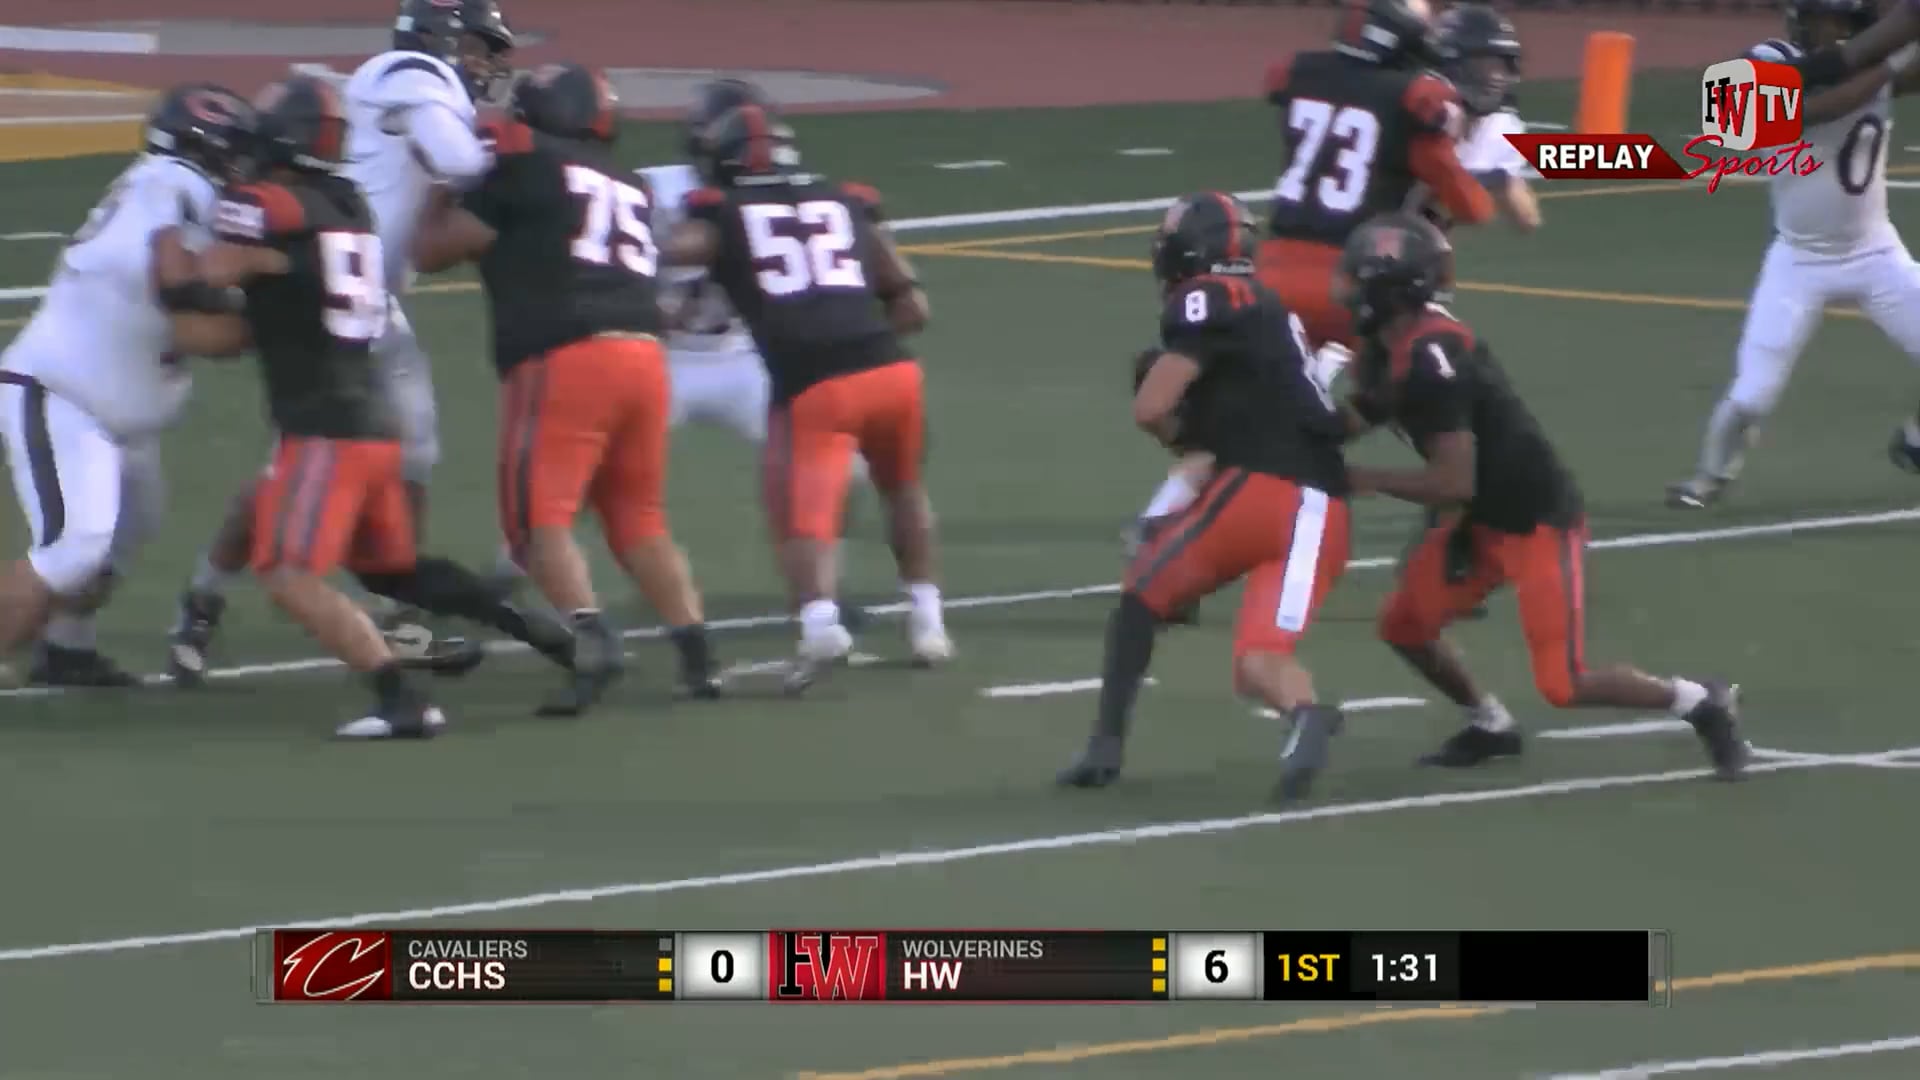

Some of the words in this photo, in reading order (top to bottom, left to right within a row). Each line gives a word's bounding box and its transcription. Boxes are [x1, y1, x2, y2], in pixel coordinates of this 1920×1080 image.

[1269, 98, 1379, 211] 73
[1838, 113, 1883, 196] 0
[563, 165, 659, 277] 75
[739, 200, 867, 296] 52
[1185, 290, 1208, 322] 8
[1427, 343, 1456, 379] 1
